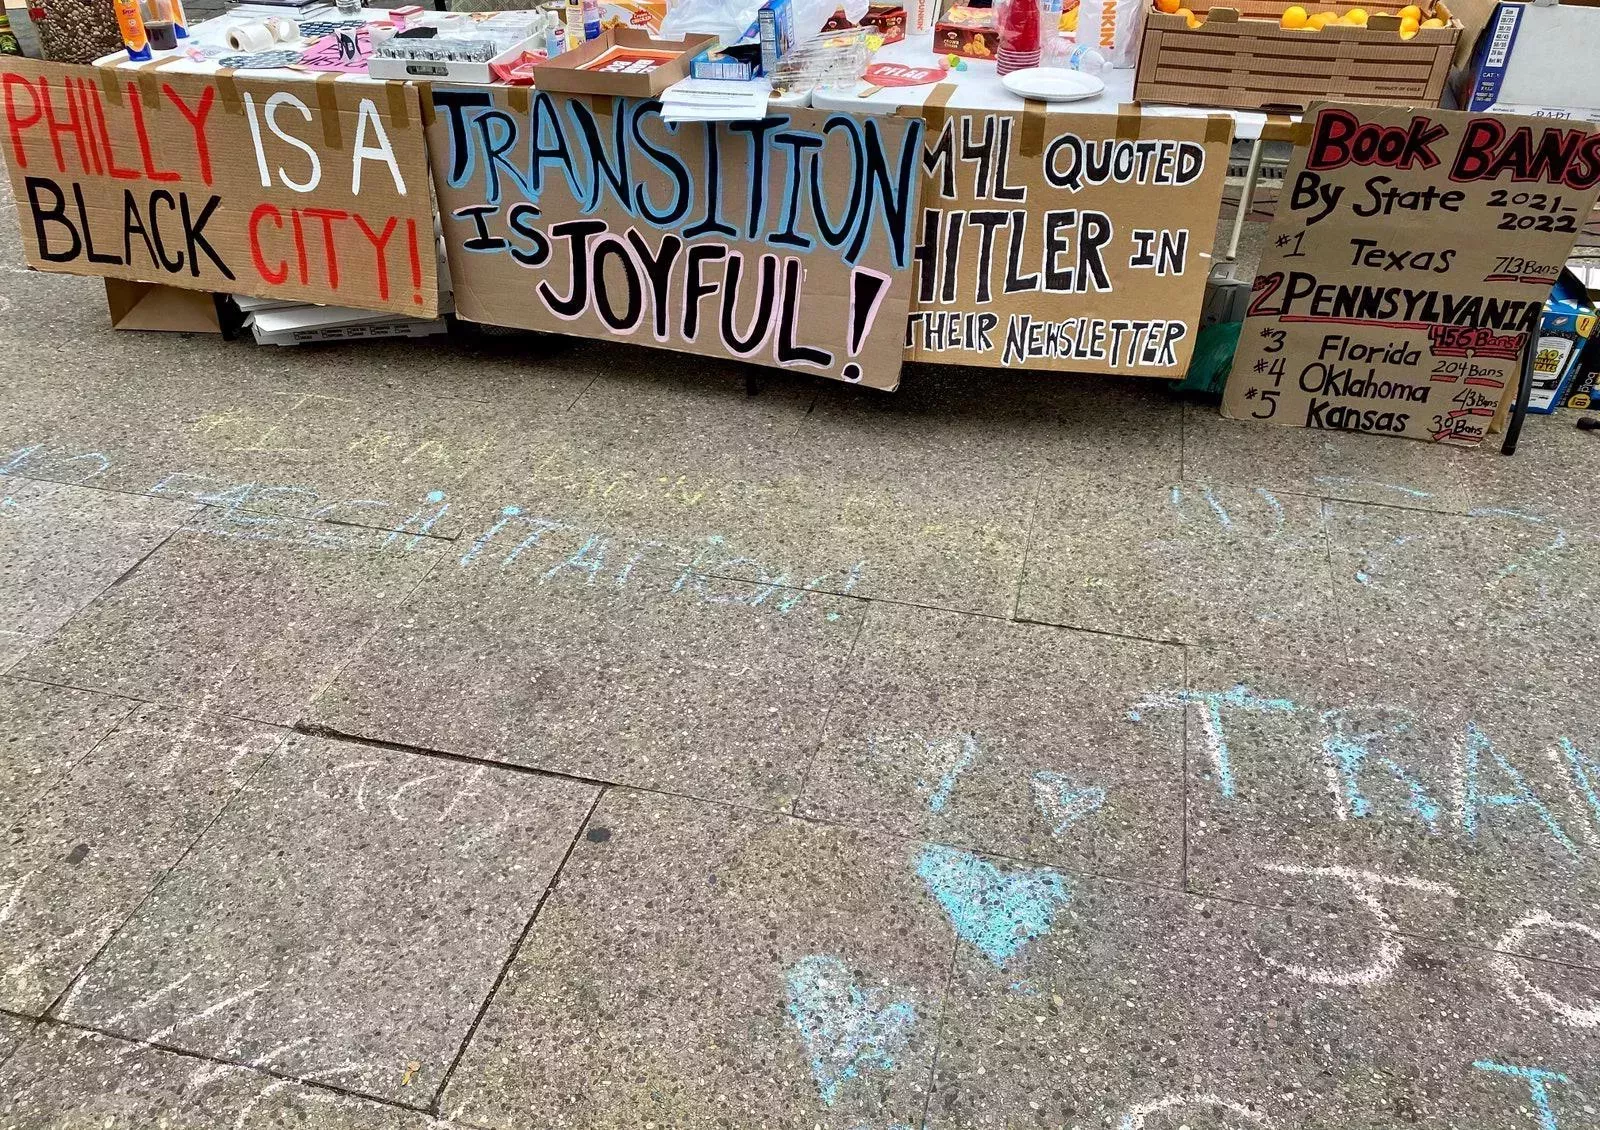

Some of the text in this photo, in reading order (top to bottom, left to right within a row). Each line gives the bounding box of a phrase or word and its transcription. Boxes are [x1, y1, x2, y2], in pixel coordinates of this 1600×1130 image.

[1, 72, 407, 196] PHILLY IS A
[1043, 132, 1206, 193] QUOTED
[1449, 118, 1600, 191] BANS
[432, 88, 925, 269] TRANSITION
[1290, 171, 1345, 227] By
[1352, 175, 1466, 217] State
[25, 176, 424, 306] BLACK CITY!
[452, 202, 552, 268] IS
[1497, 212, 1578, 233] 2022
[1129, 229, 1189, 277] IN
[1274, 230, 1306, 258] #1
[1350, 238, 1456, 274] Texas
[536, 219, 891, 382] JOYFUL!
[1280, 272, 1544, 333] PENNSYLVANIA
[1001, 314, 1187, 369] NEWSLETTER
[1259, 327, 1287, 353] #3
[1318, 334, 1422, 366] Florida
[1253, 357, 1287, 388] #4
[1244, 387, 1281, 420] #5
[1305, 397, 1410, 433] Kansas
